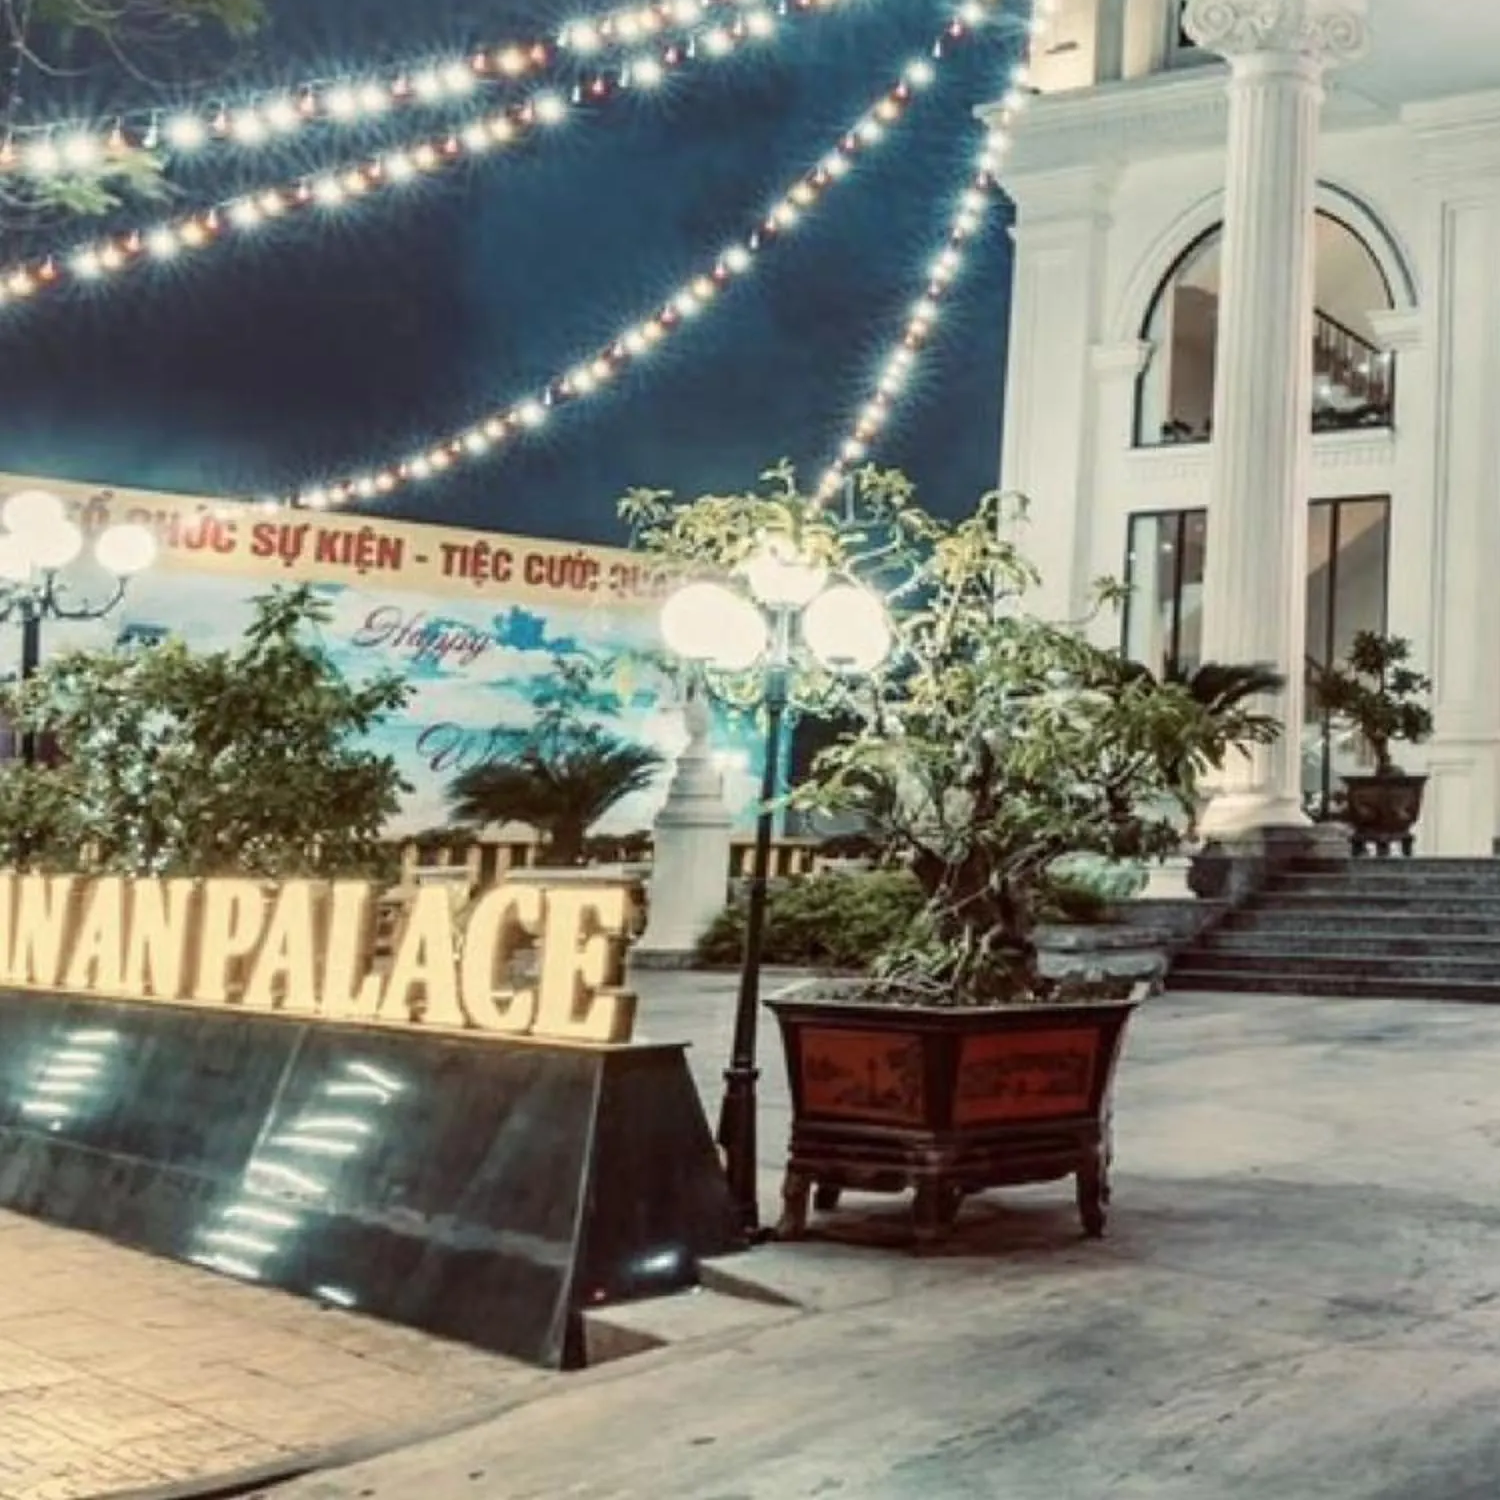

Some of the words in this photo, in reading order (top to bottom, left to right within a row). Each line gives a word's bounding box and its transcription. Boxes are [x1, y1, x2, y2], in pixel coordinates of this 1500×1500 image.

[251, 522, 311, 568] SỰ
[314, 524, 405, 576] KIỆN
[439, 538, 514, 588] TIỆC
